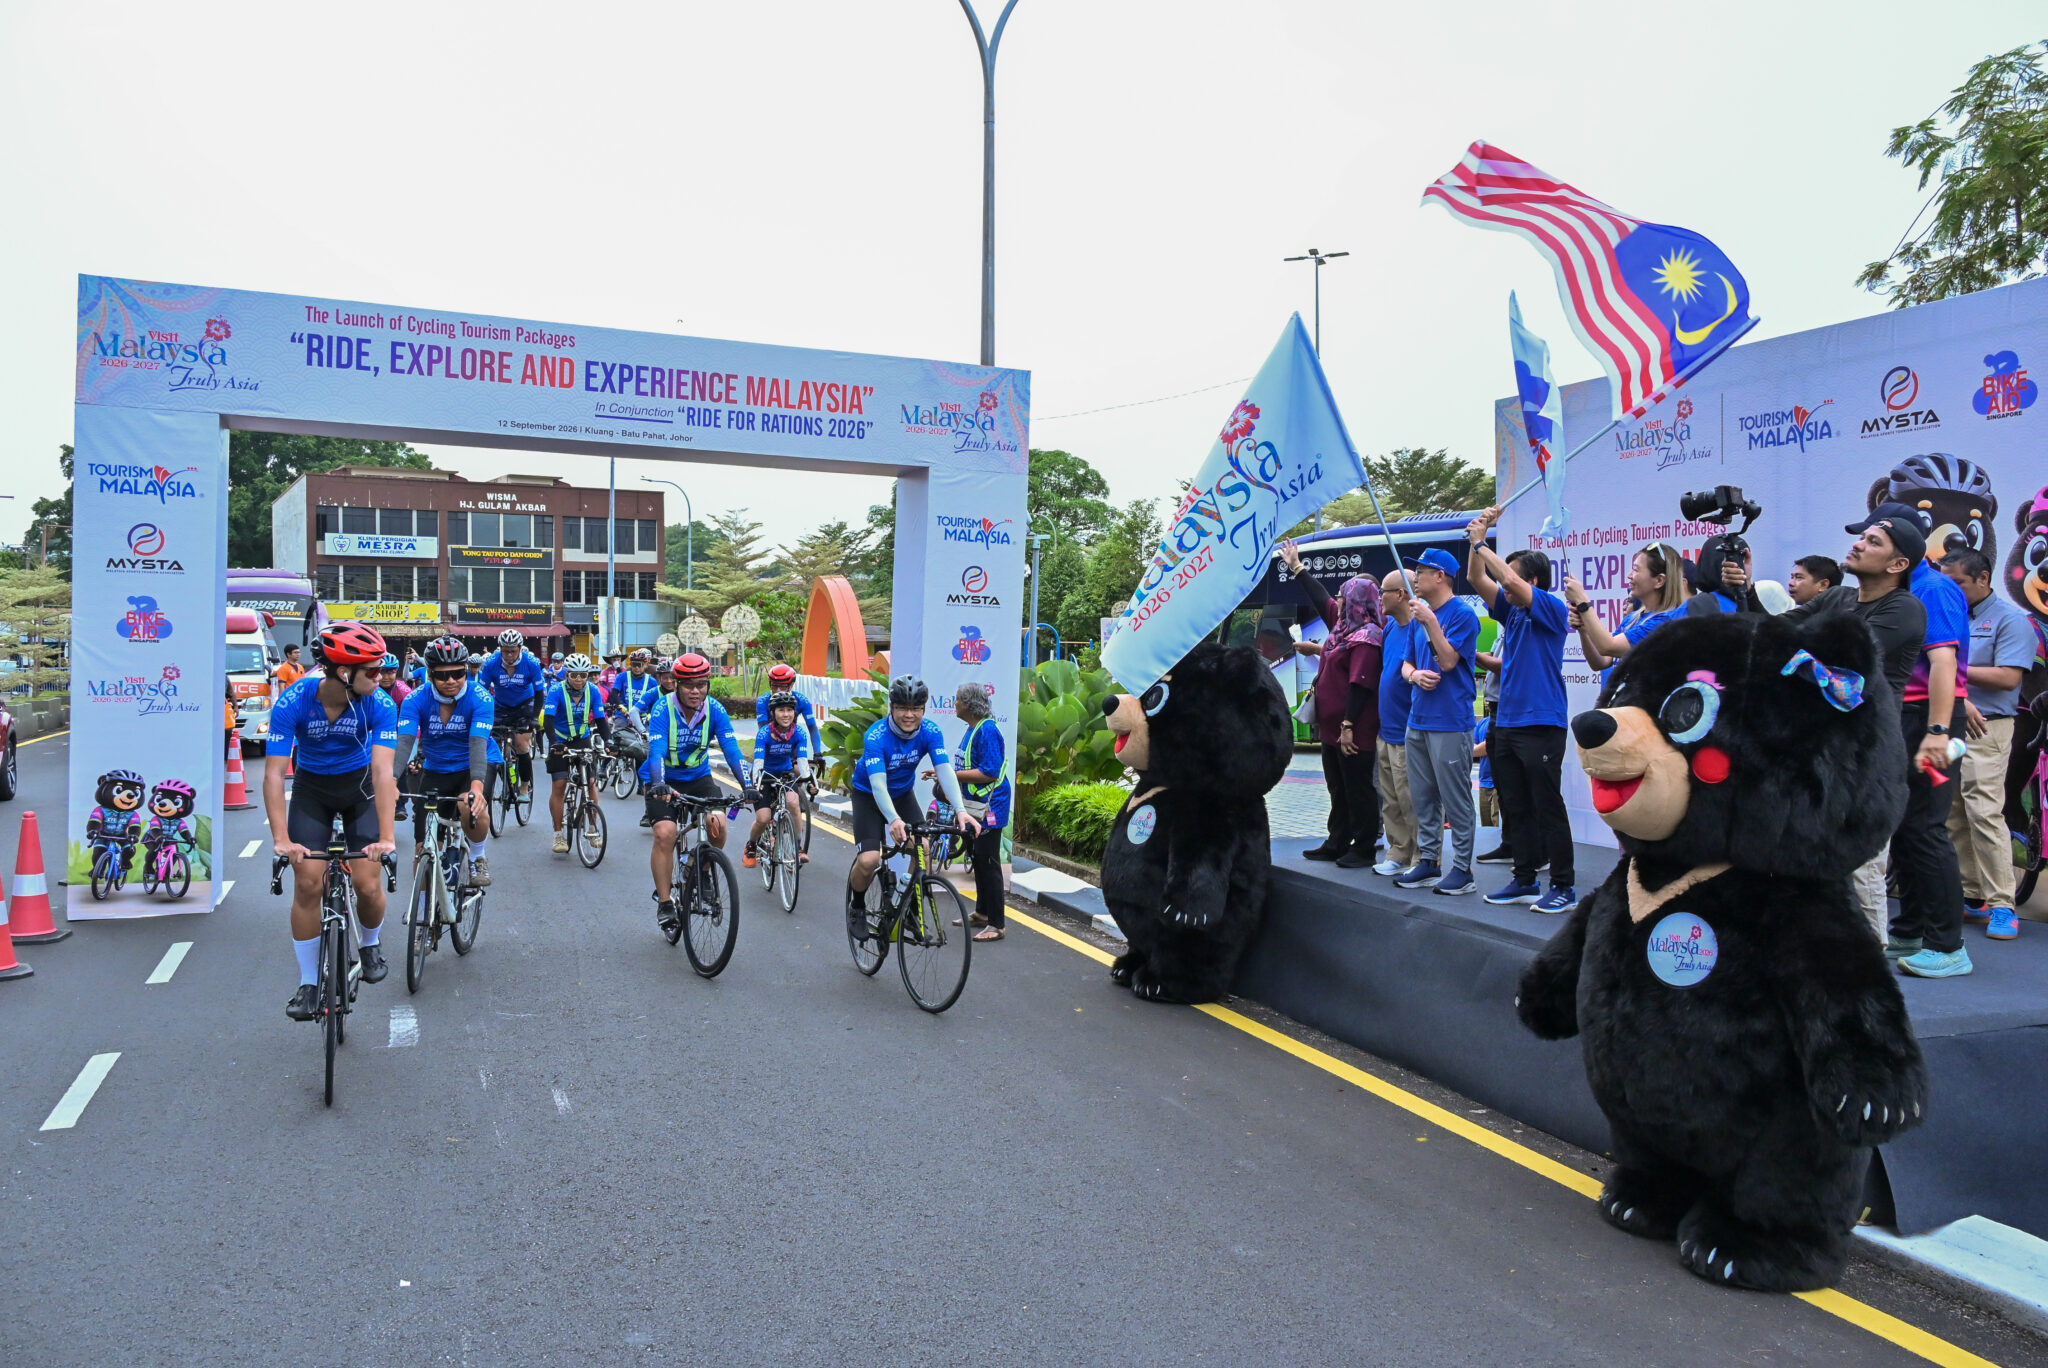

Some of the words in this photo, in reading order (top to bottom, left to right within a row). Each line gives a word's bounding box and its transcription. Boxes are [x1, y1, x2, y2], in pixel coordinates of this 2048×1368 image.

[305, 305, 329, 324] The
[335, 308, 384, 330] Launch
[389, 314, 403, 331] of
[407, 315, 456, 339] Cycling
[460, 320, 511, 341] Tourism
[516, 326, 576, 349] Packages
[91, 331, 228, 368] Malaysia
[168, 365, 220, 391] Truly
[223, 376, 260, 391] Asia
[390, 340, 513, 384] EXPLORE
[520, 353, 575, 389] AND
[584, 360, 739, 405] EXPERIENCE
[1983, 370, 2028, 396] BIKE
[1987, 391, 2020, 415] AID
[595, 402, 606, 413] In
[609, 403, 674, 419] Conjunction
[728, 410, 756, 431] FOR
[761, 412, 823, 437] RATIONS
[899, 404, 995, 434] Malaysia
[1739, 408, 1793, 432] TOURISM
[1861, 409, 1940, 434] MYSTA
[1986, 410, 2022, 420] SINGAPORE
[497, 419, 508, 428] 12
[510, 420, 556, 432] September
[558, 425, 578, 433] 2026
[585, 426, 614, 438] Kluang
[621, 430, 640, 439] Batu
[669, 433, 693, 442] Johor
[1615, 422, 1691, 453] Malaysia
[1749, 419, 1832, 453] MALAYSIA
[953, 431, 990, 453] Truly
[992, 440, 1018, 452] Asia
[1689, 447, 1712, 460] Asia
[88, 463, 153, 479] TOURISM
[100, 477, 195, 505] MALAYSIA
[1279, 462, 1324, 504] sia
[459, 500, 475, 509] HJ.
[477, 501, 510, 510] GULAM
[515, 503, 547, 512] AKBAR
[486, 492, 517, 502] WISMA
[936, 515, 982, 529] TOURISM
[944, 527, 1010, 550] MALAYSIA
[1528, 533, 1543, 550] The
[1581, 528, 1590, 545] of
[1593, 526, 1628, 547] Cycling
[1631, 521, 1671, 541] Tourism
[357, 541, 416, 551] MESRA
[106, 557, 184, 571] MYSTA
[1129, 545, 1215, 632] 2026-2027
[946, 594, 1000, 605] MYSTA
[125, 611, 165, 626] BIKE
[375, 609, 404, 618] SHOP
[129, 625, 158, 639] AID
[958, 638, 986, 651] BIKE
[960, 650, 981, 661] AID
[1562, 673, 1589, 684] ember
[1592, 674, 1602, 684] 20
[87, 680, 178, 701] Malaysia
[373, 690, 394, 708] SC
[138, 698, 173, 716] Truly
[175, 702, 200, 712] Asia
[397, 719, 410, 727] HP
[867, 723, 887, 741] USC
[266, 733, 284, 742] HP
[380, 731, 397, 740] BH
